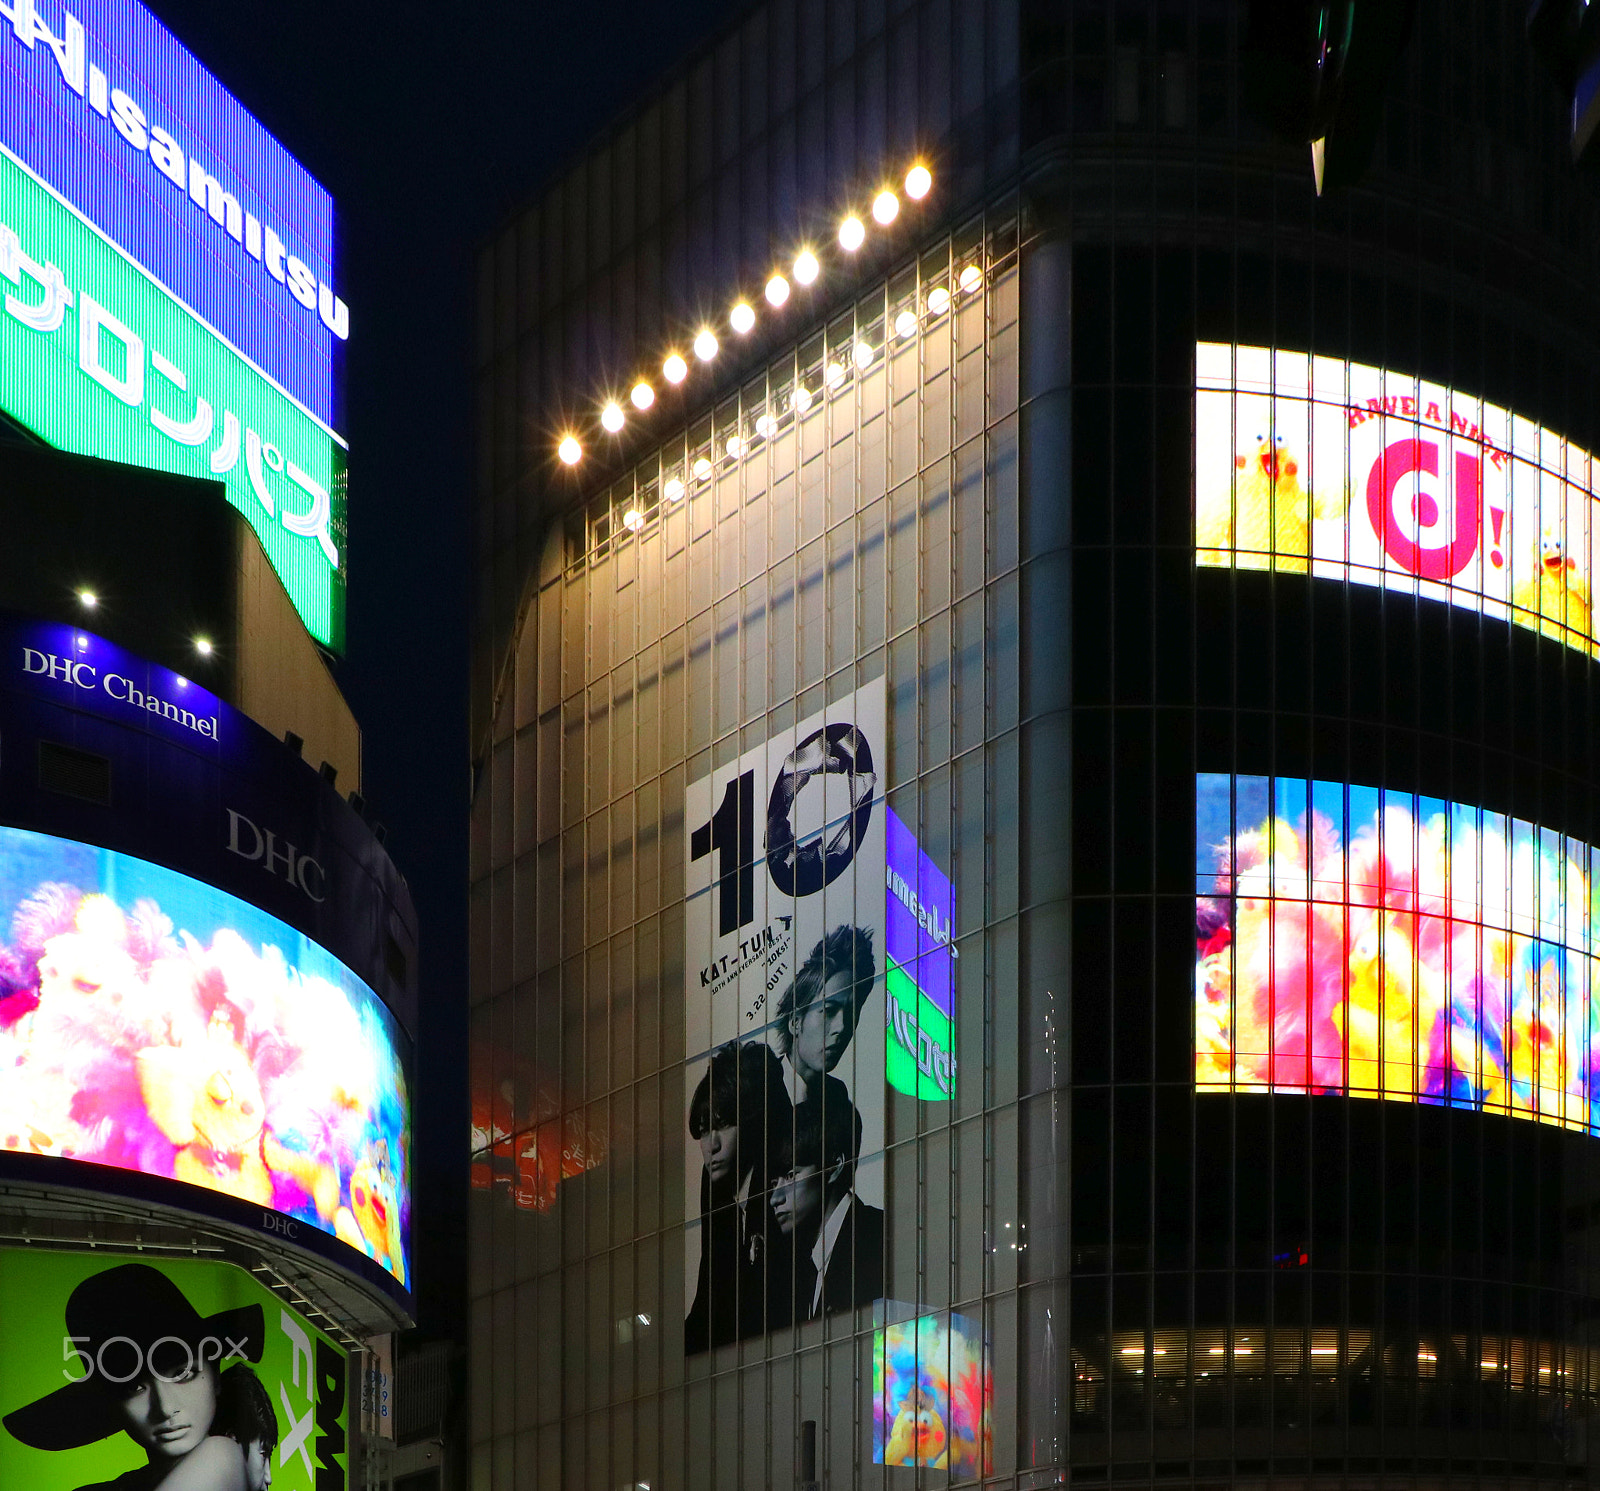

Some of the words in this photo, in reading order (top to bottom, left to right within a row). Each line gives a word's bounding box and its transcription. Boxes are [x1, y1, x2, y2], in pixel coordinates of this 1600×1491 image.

[0, 222, 338, 568] サロンパス
[1343, 395, 1415, 429] HAVE
[1425, 402, 1442, 424] A
[22, 647, 96, 690] DHC
[103, 673, 219, 742] Channel
[226, 808, 325, 903] DHC
[691, 722, 877, 937] 10
[700, 925, 774, 988] KAT-TUN
[711, 980, 726, 995] 10TH
[767, 933, 784, 949] BEST
[746, 994, 766, 1021] 3.22
[766, 962, 788, 991] OUT!
[262, 1212, 299, 1239] DHC
